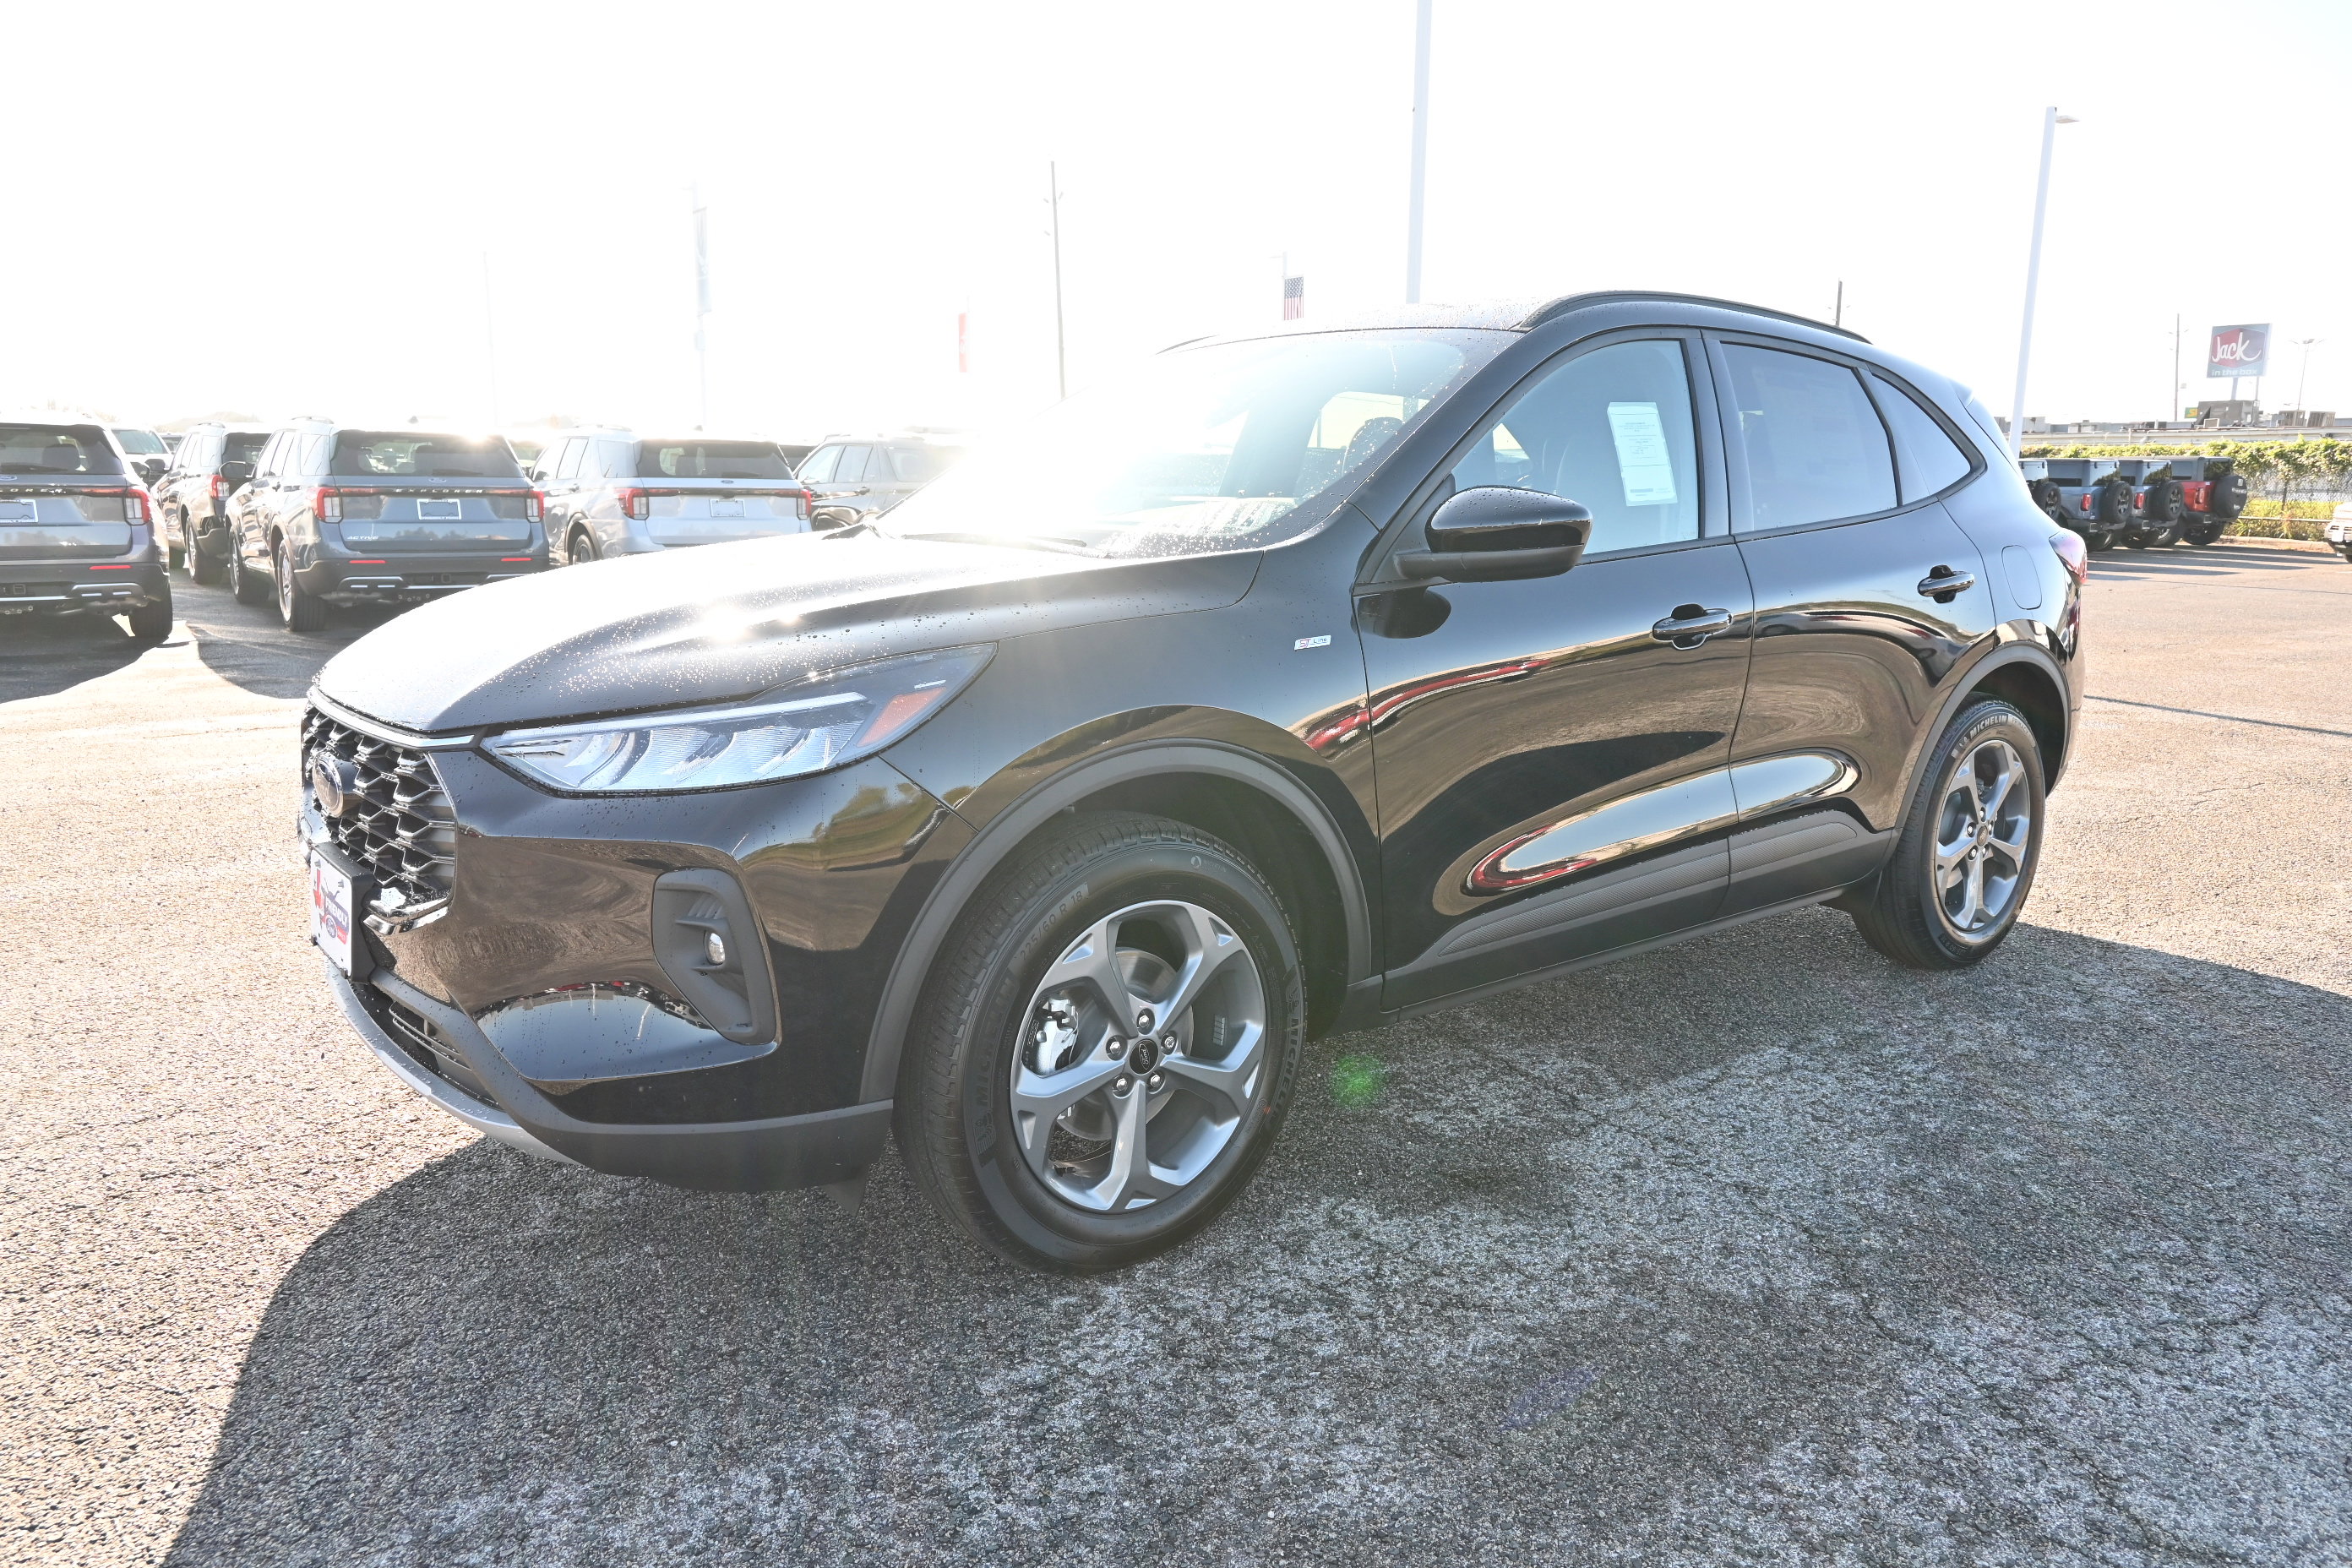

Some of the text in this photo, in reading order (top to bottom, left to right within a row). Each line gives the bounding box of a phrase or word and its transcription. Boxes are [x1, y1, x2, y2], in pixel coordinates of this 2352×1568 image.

[2211, 331, 2262, 362] Jack
[1969, 714, 2008, 739] MICHELIN
[325, 896, 348, 927] FRIENDLY
[1020, 913, 1056, 961] 225/60
[1059, 903, 1068, 915] R
[1070, 890, 1083, 905] 18
[1270, 1017, 1300, 1124] MICHELIN
